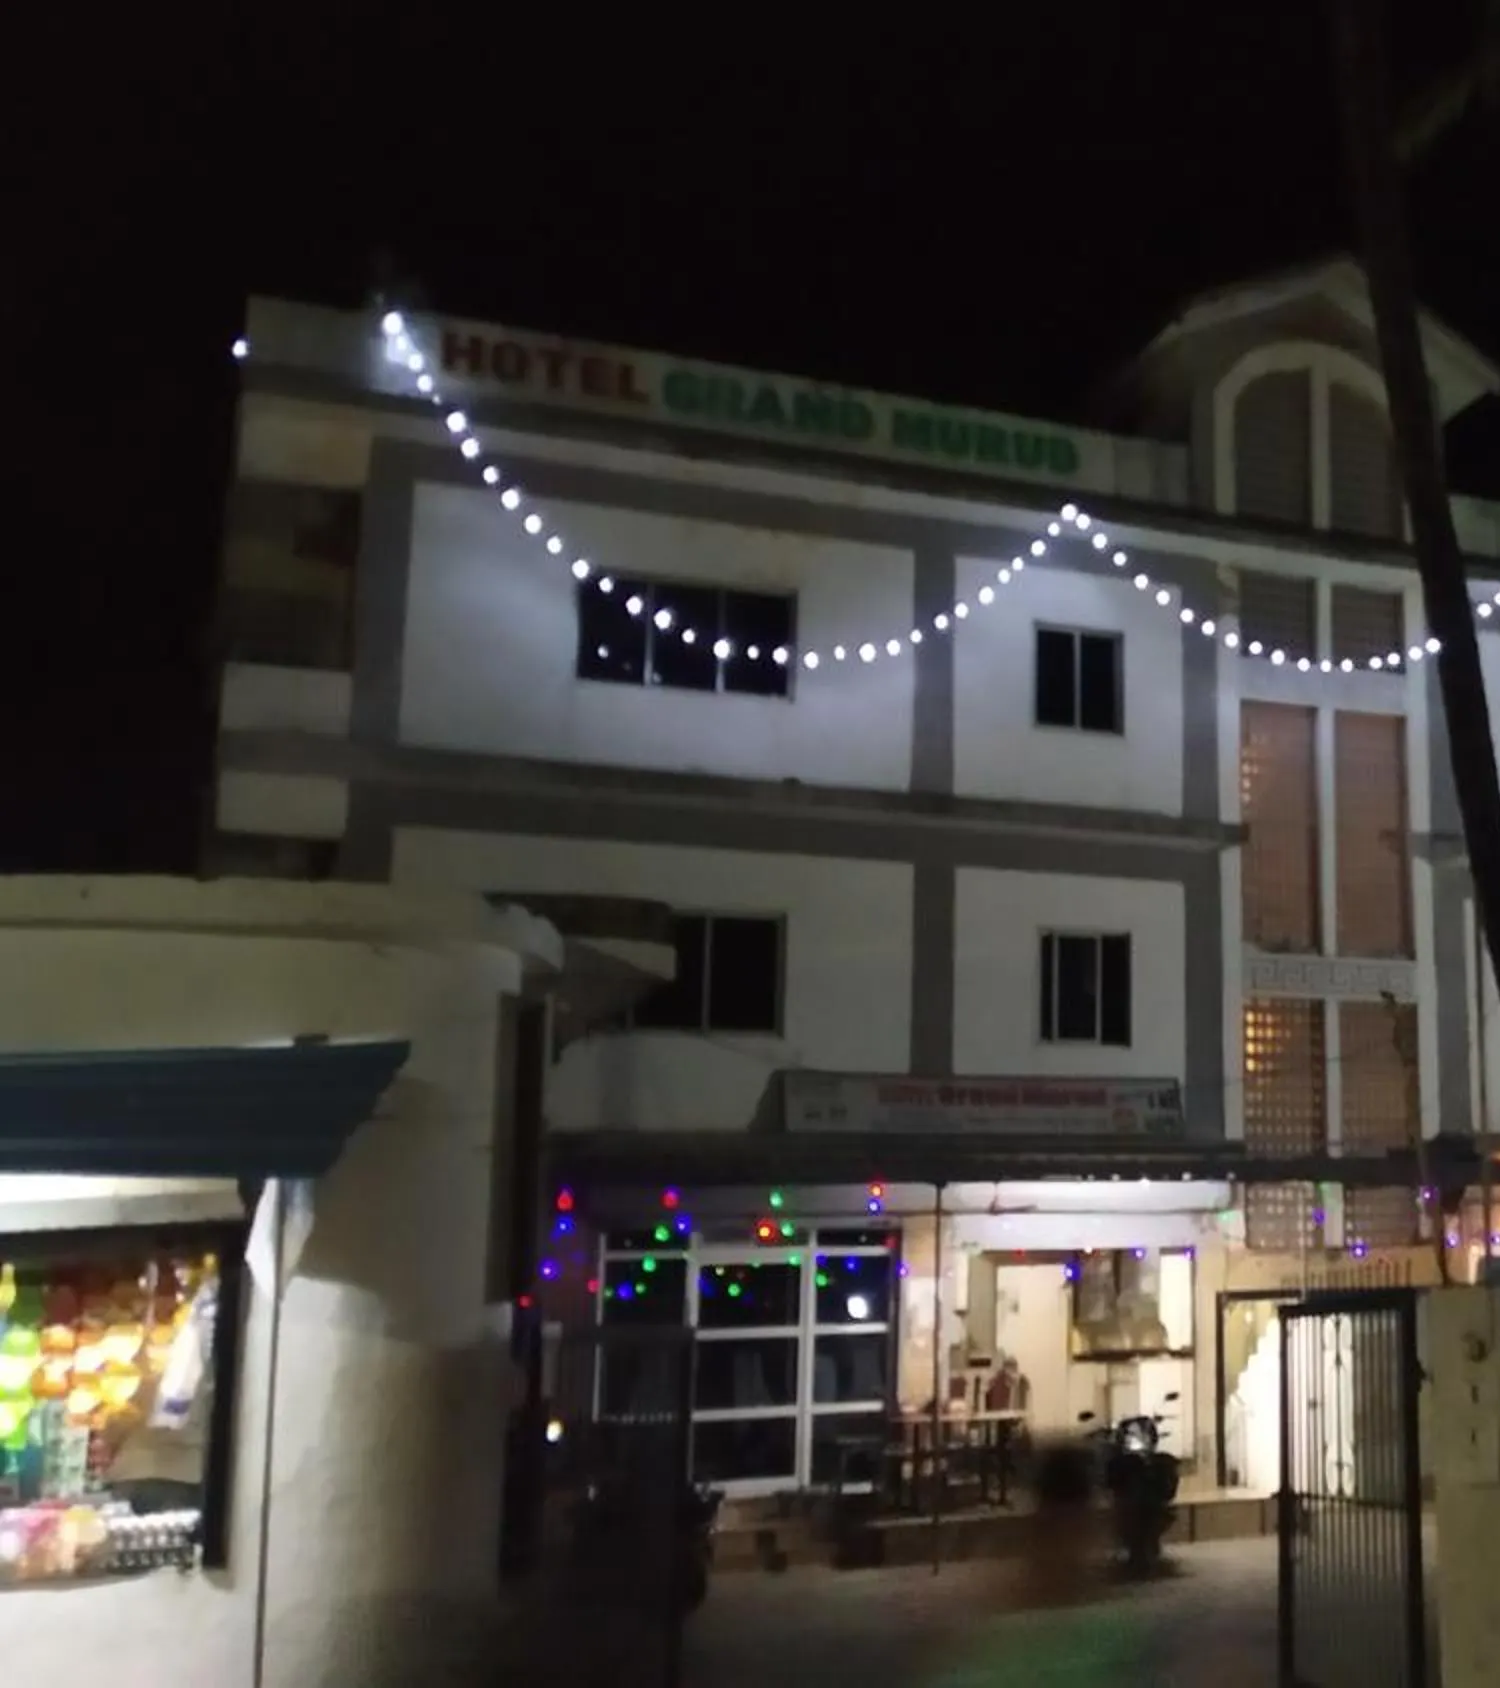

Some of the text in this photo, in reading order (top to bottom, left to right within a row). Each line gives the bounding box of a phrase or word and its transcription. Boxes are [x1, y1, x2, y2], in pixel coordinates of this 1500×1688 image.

[444, 332, 1079, 475] HOTEL GRAND MURUD
